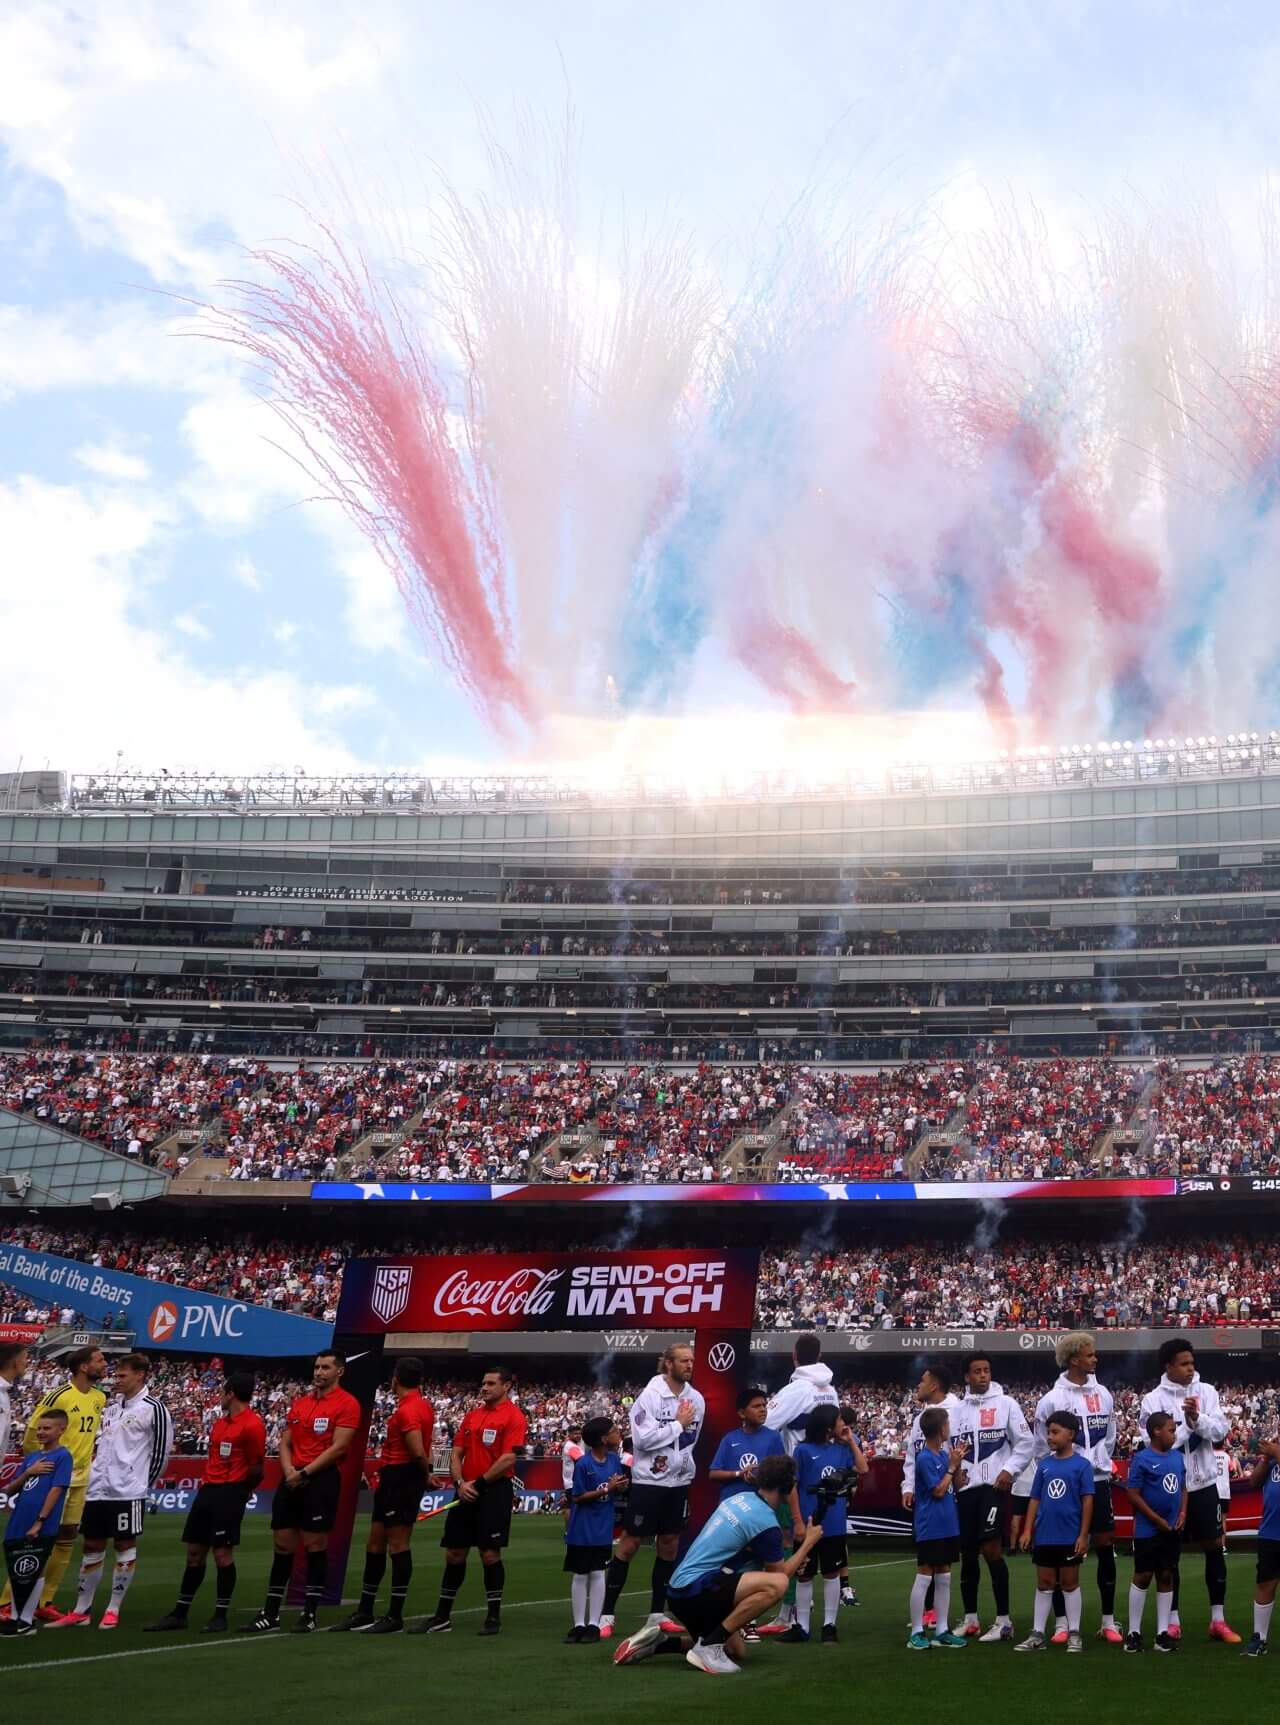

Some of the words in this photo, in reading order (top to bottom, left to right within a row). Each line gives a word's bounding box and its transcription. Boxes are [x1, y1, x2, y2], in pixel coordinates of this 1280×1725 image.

[1191, 1183, 1214, 1191] USA
[14, 1255, 47, 1282] Bank
[49, 1267, 67, 1288] of
[65, 1272, 88, 1293] the
[89, 1275, 134, 1306] Bears
[378, 1269, 409, 1290] USA
[570, 1262, 726, 1287] SEND-OFF
[433, 1268, 567, 1317] Coca-Cola
[566, 1283, 724, 1317] MATCH
[181, 1303, 248, 1339] PNC
[74, 1334, 89, 1344] 101
[604, 1335, 649, 1346] VIZZY
[901, 1337, 958, 1347] UNITED
[80, 1416, 94, 1433] 12
[979, 1430, 1005, 1440] Football
[118, 1513, 129, 1531] 6
[987, 1507, 998, 1526] 4
